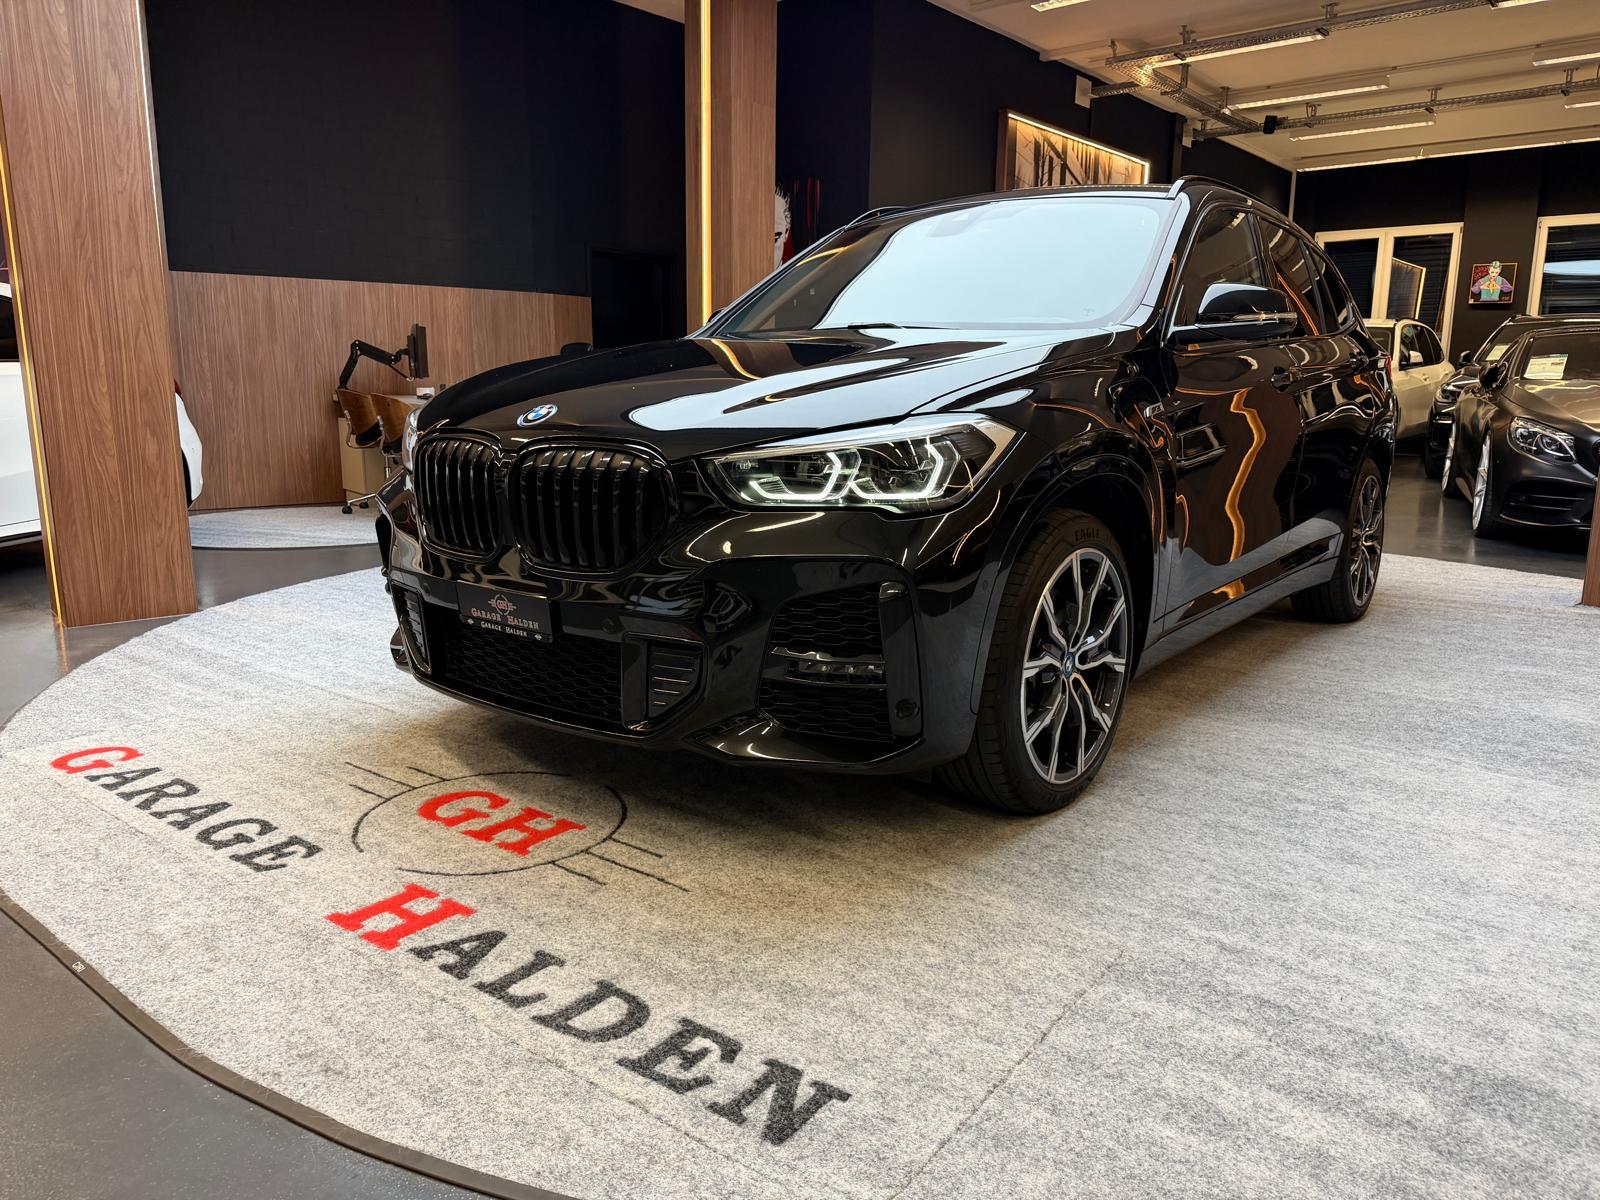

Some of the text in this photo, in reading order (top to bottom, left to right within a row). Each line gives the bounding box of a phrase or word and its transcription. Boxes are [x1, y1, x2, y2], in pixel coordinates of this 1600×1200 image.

[471, 607, 540, 631] GARAGE HALDEN
[480, 621, 528, 637] GARAGE HALDEN
[417, 790, 587, 857] GH
[51, 746, 851, 1145] GARAGE HALDEN
